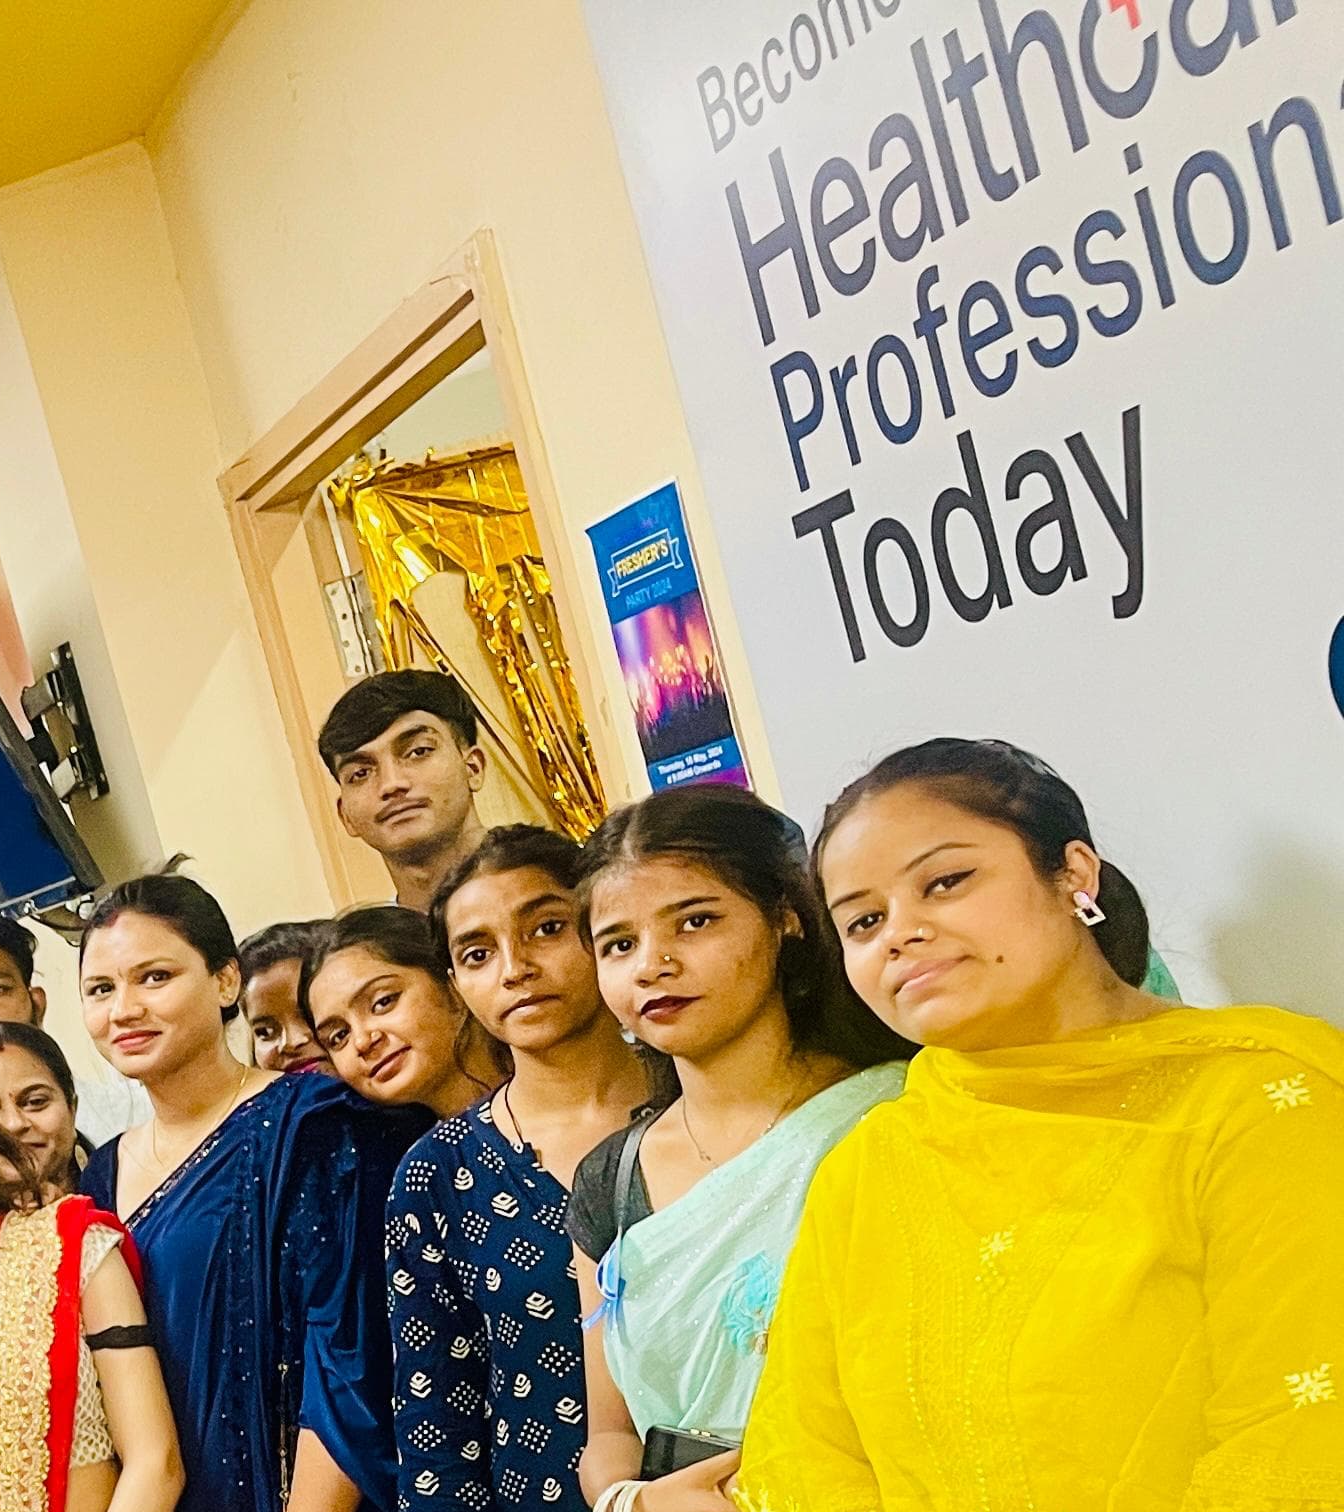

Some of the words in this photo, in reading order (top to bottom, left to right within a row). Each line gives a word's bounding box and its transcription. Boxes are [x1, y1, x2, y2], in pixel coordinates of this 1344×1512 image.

[696, 0, 901, 153] Becom
[724, 0, 1298, 347] Healthca
[770, 78, 1344, 492] Profession
[615, 539, 669, 579] FRESHER'S
[791, 404, 1144, 663] Today
